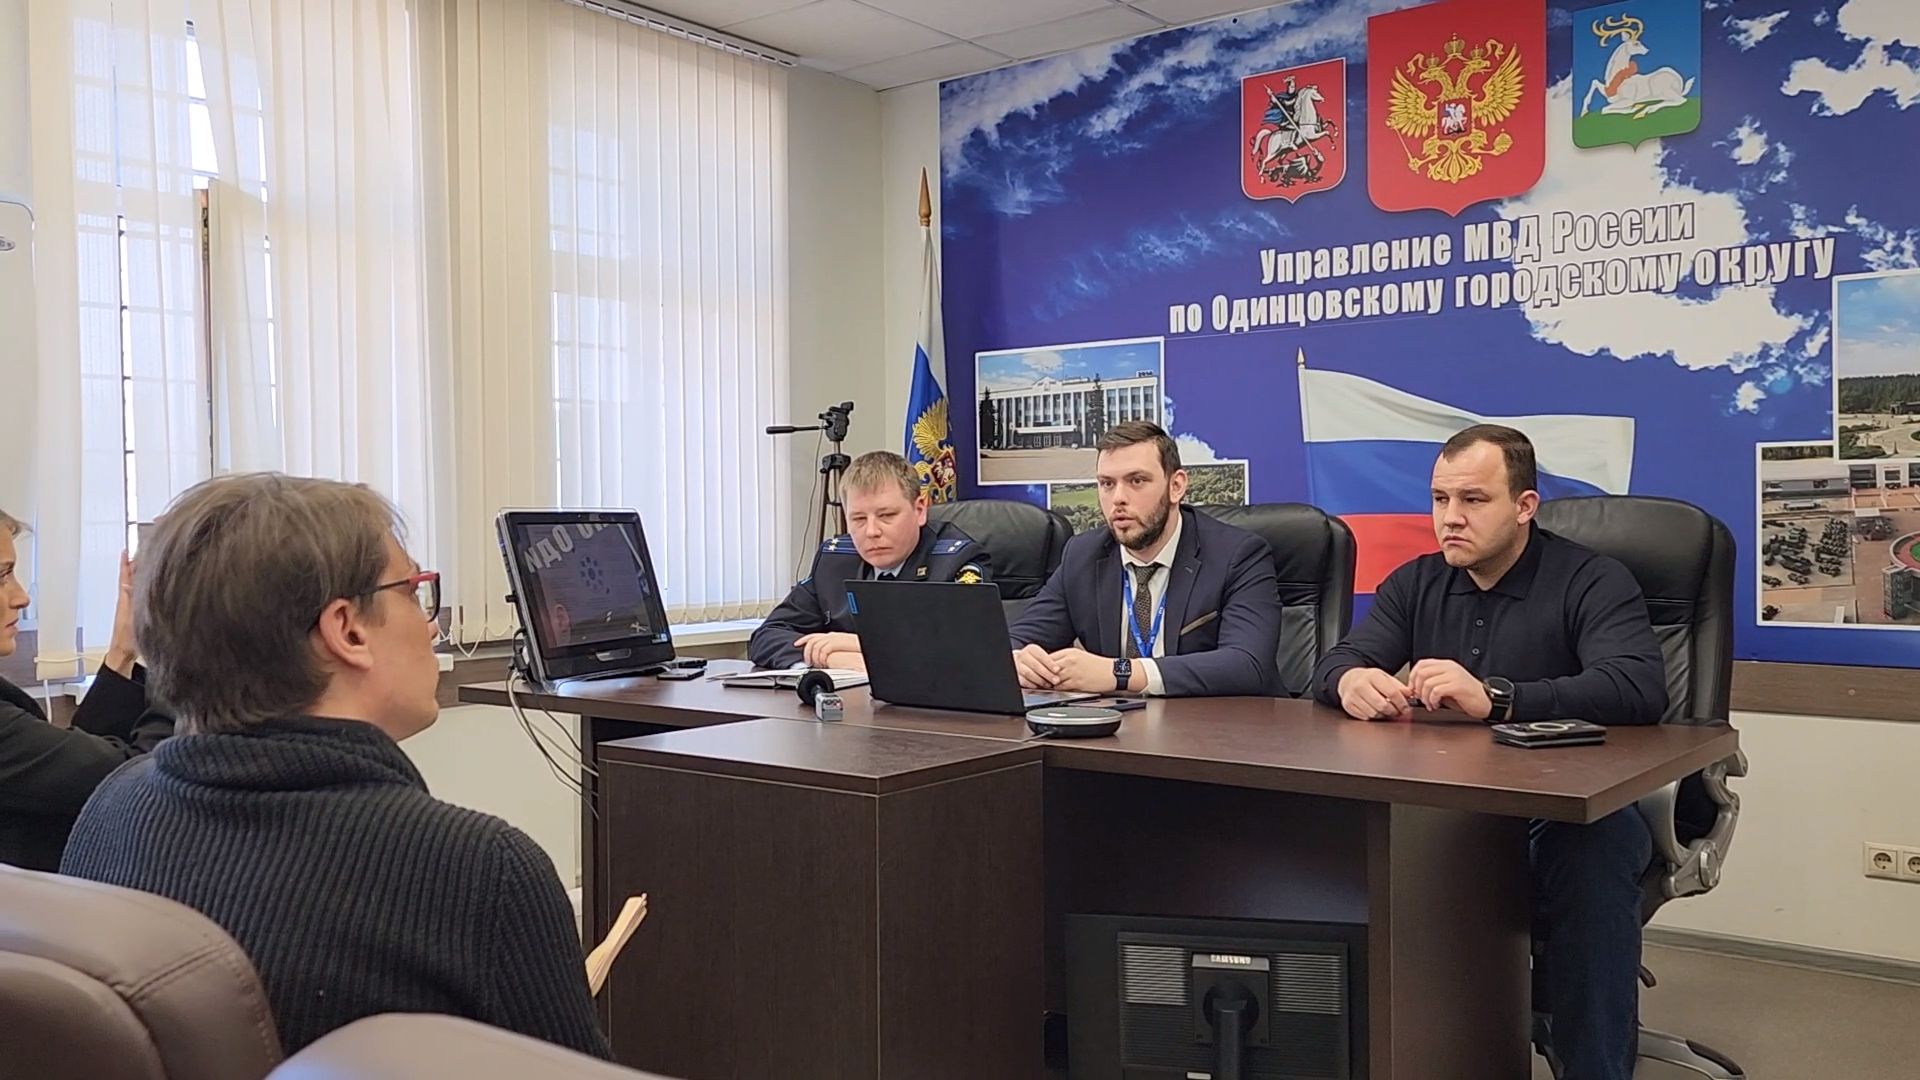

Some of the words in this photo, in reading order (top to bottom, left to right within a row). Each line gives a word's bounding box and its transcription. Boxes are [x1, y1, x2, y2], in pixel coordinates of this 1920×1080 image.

[1169, 303, 1203, 334] по
[1211, 278, 1445, 334] Одинцовскому
[1455, 252, 1682, 309] городскому
[1694, 237, 1836, 288] округу
[1260, 233, 1452, 285] Управление
[1463, 215, 1541, 263] МВД
[1552, 202, 1695, 254] России
